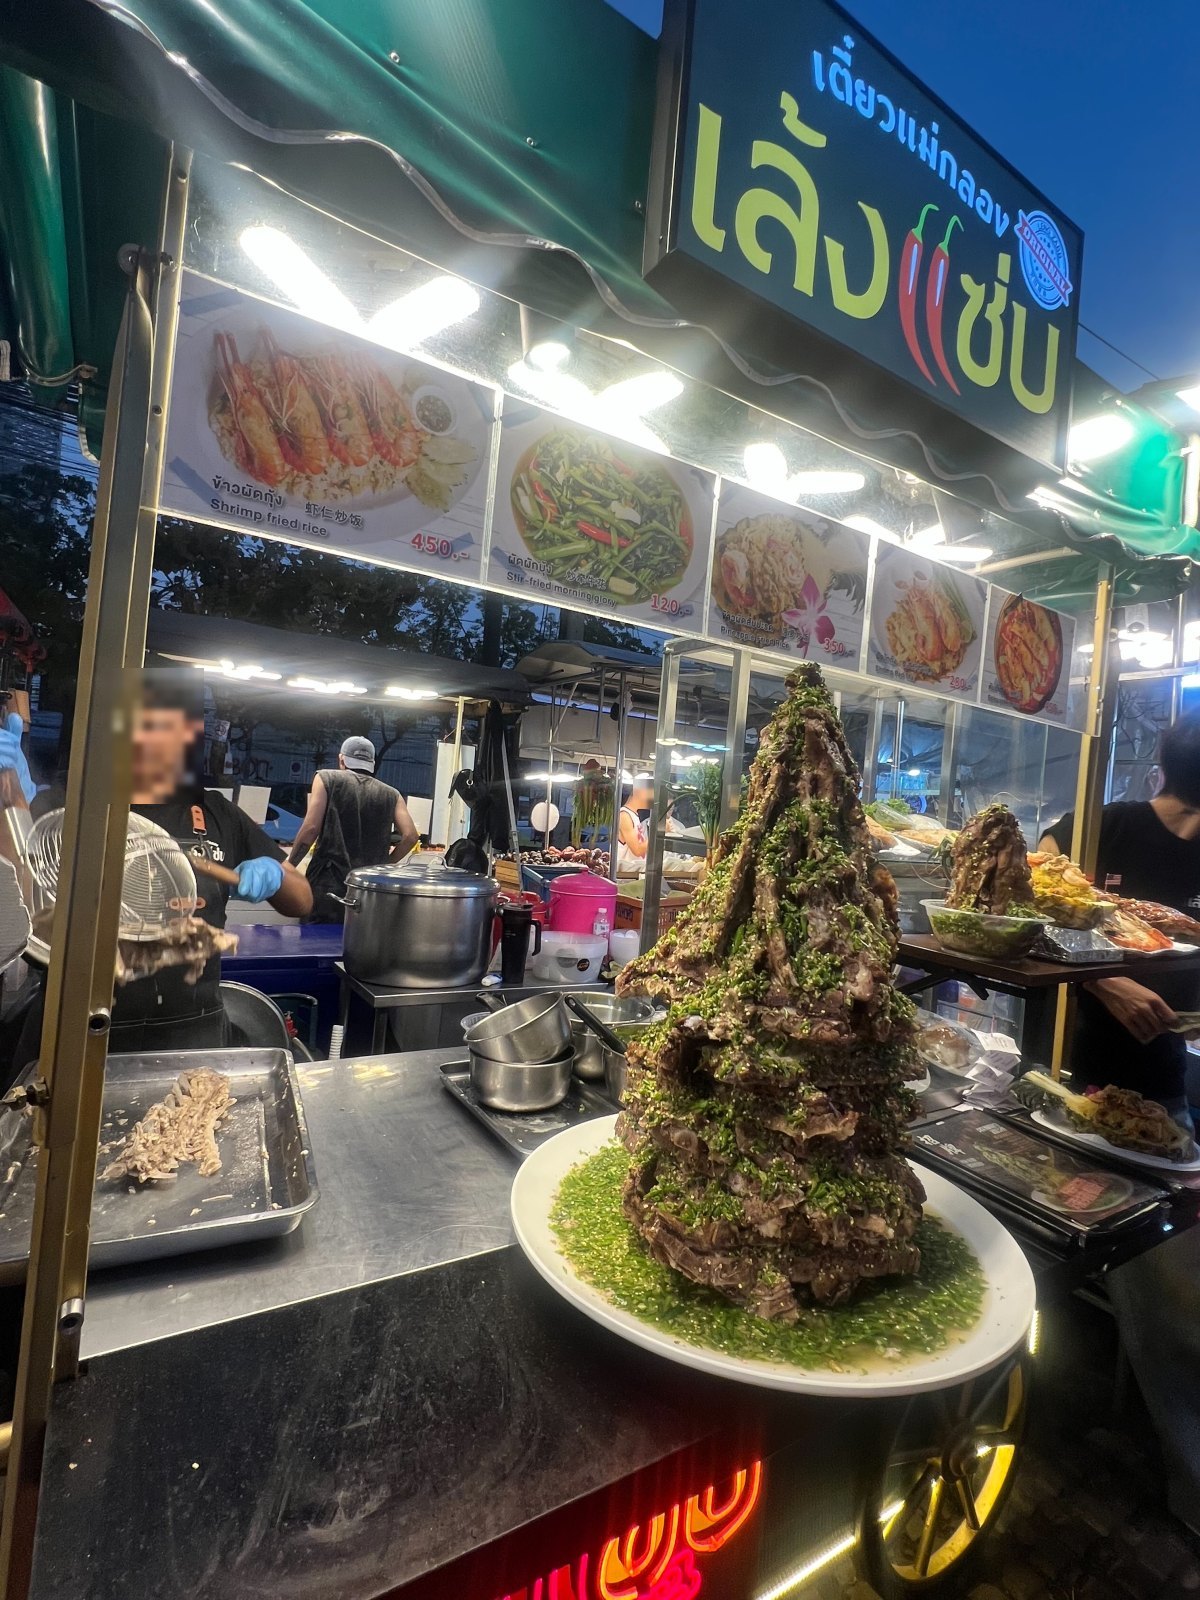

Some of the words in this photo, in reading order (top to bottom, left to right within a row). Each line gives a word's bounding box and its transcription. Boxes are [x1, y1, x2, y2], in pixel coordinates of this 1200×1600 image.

[1022, 226, 1067, 293] ORIGINAL
[212, 475, 282, 507] ข้าวผัดกุ้ง
[210, 498, 262, 521] Shrimp
[267, 512, 298, 528] fried
[302, 522, 327, 535] rice
[305, 501, 363, 527] 虾仁炒饭
[411, 533, 470, 560] 450.-
[508, 553, 553, 576] ผัดผักบุ้ง
[507, 571, 552, 590] Stir-fried
[650, 594, 692, 617] 120.-
